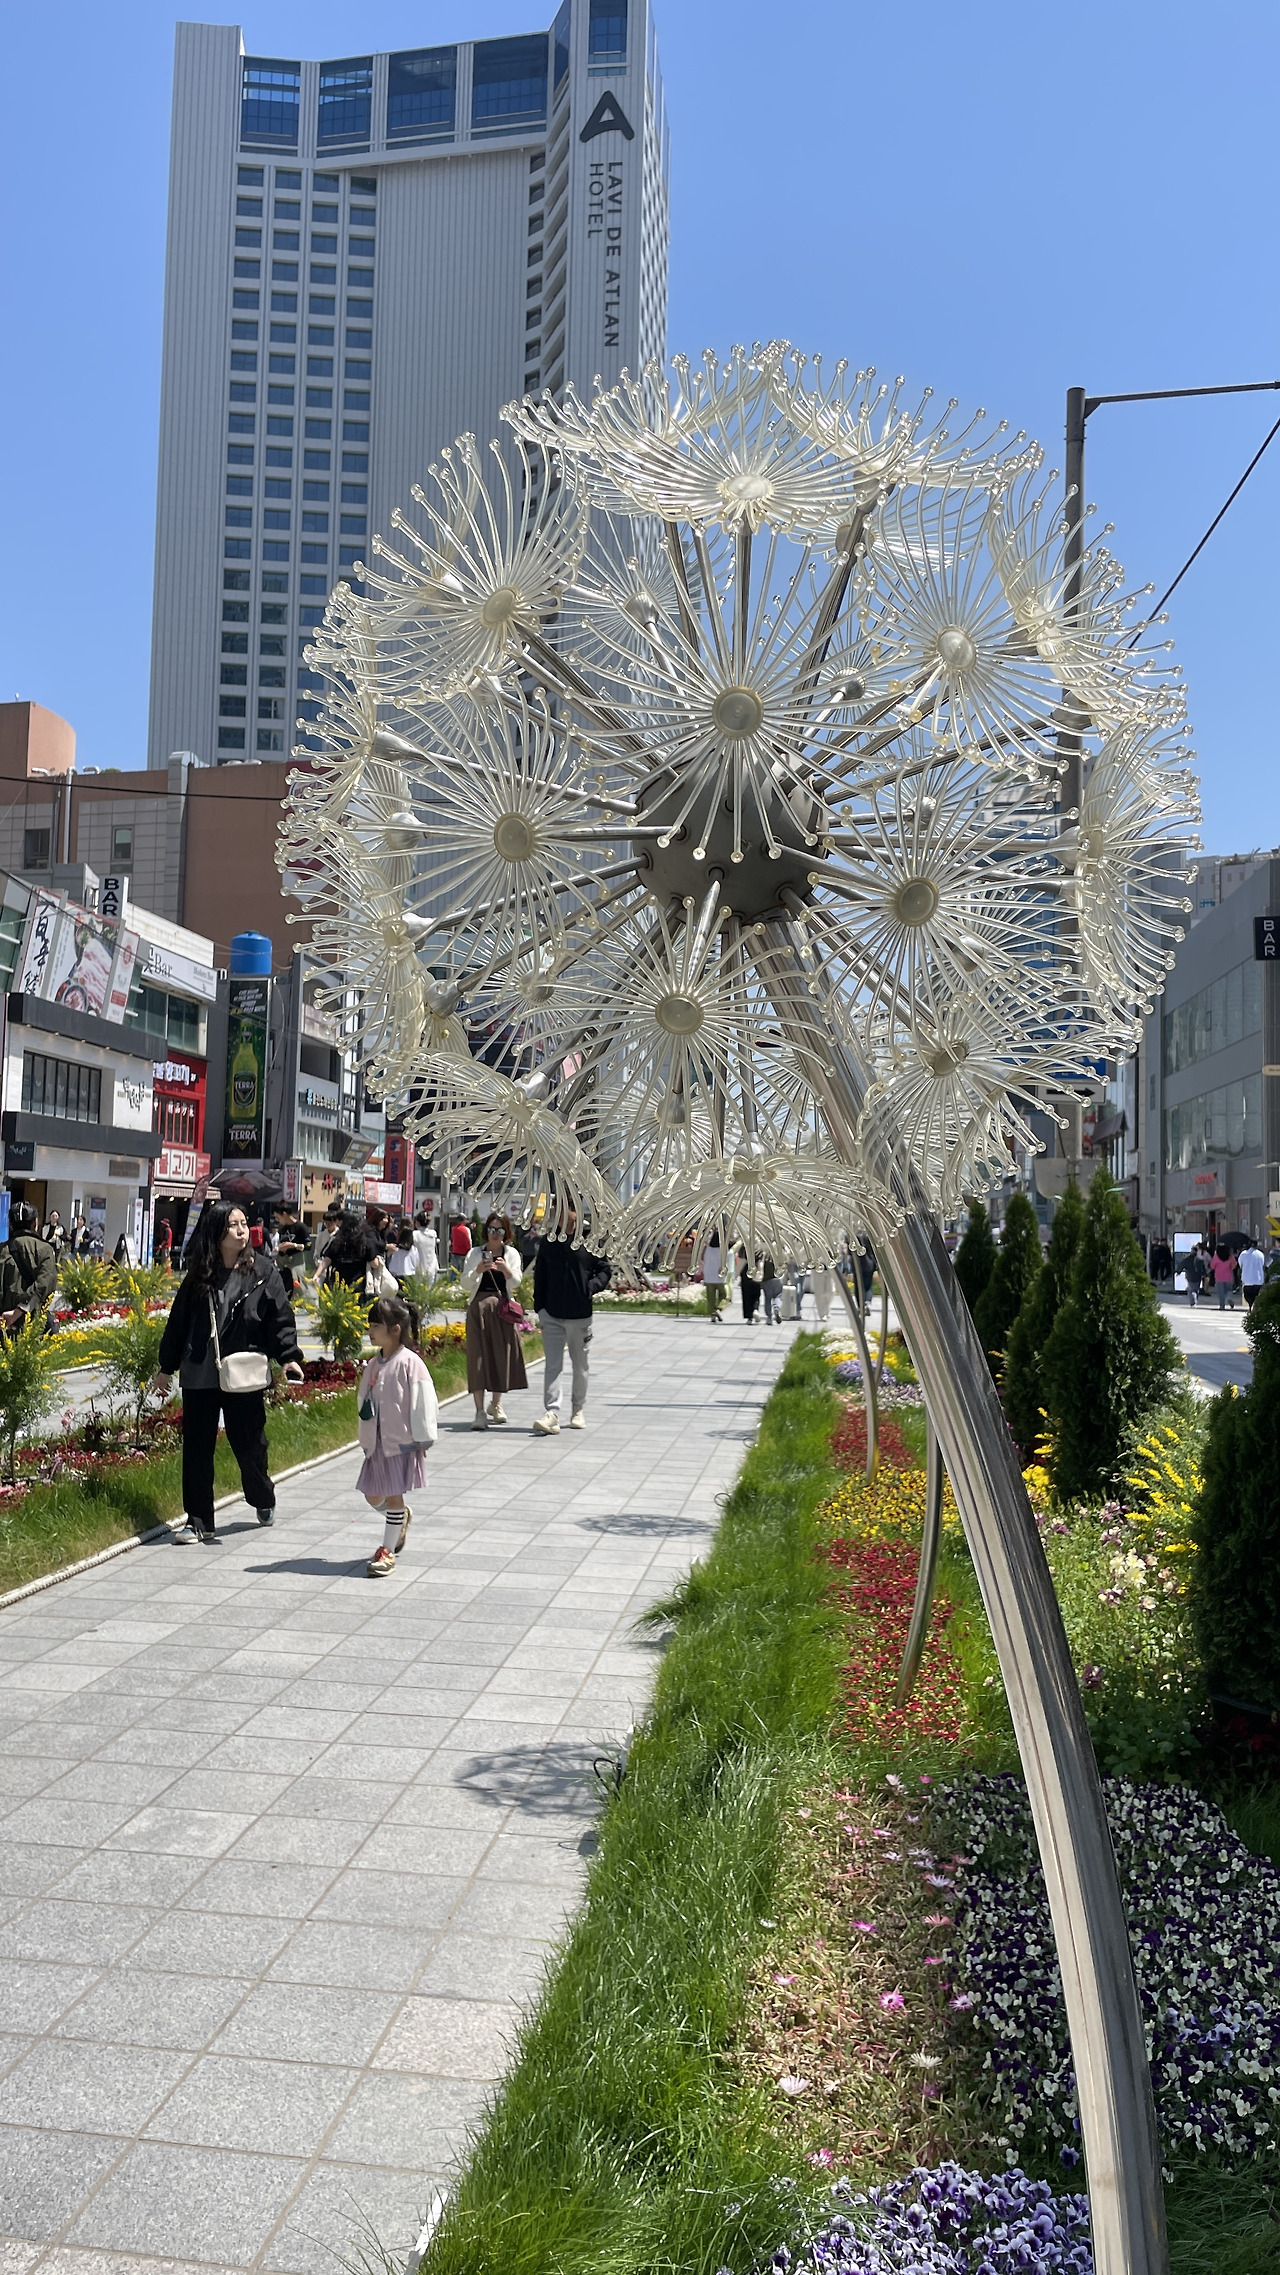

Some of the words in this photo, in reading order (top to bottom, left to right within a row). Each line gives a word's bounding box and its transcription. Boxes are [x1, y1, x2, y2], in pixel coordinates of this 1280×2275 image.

[587, 163, 604, 240] HOTEL
[607, 161, 623, 214] LAVI
[606, 227, 621, 257] DE
[604, 269, 621, 347] ATLAN
[102, 878, 119, 917] BAR
[1263, 919, 1275, 956] BAR
[235, 1080, 254, 1089] TERRA
[229, 1129, 257, 1141] TERRA
